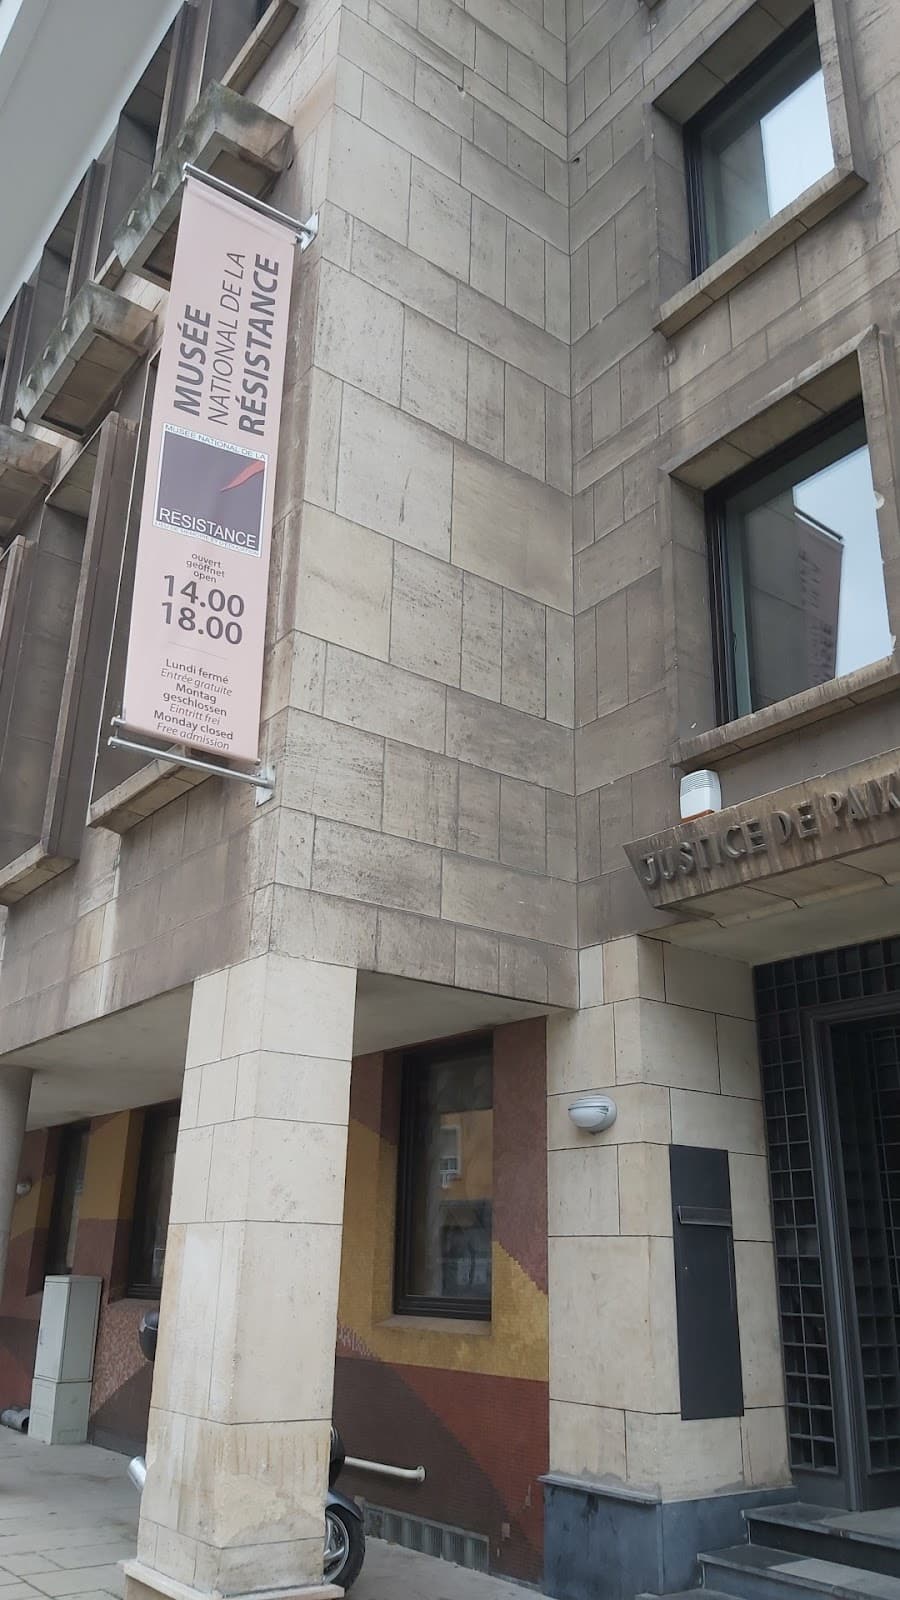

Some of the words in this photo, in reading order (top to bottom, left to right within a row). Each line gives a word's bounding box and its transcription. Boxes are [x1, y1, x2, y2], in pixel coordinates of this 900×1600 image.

[224, 252, 246, 280] LA
[220, 280, 242, 312] DE
[174, 304, 211, 416] MUSÉE
[236, 253, 279, 436] RÉSISTANCE
[208, 319, 238, 425] NATIONAL
[165, 424, 197, 438] MUSEE
[198, 434, 240, 452] NATIONAL
[241, 447, 254, 457] DE
[254, 452, 266, 460] LA
[159, 507, 257, 549] RESISTANCE
[191, 553, 221, 568] ouvert
[193, 570, 217, 584] open
[164, 575, 244, 617] 14.00
[161, 602, 243, 645] 18.00
[160, 668, 193, 683] Entrée
[194, 679, 233, 697] gratuite
[166, 658, 196, 674] Lundi
[198, 667, 229, 684] fermé
[162, 692, 227, 717] geschlossen
[175, 682, 217, 705] Montag
[153, 709, 198, 732] Monday
[200, 724, 233, 741] closed
[169, 703, 203, 720] Eintritt
[203, 713, 220, 726] frei
[156, 721, 178, 736] Free
[179, 730, 230, 750] admission
[641, 818, 768, 886] JUSTICE
[774, 801, 820, 845] DE
